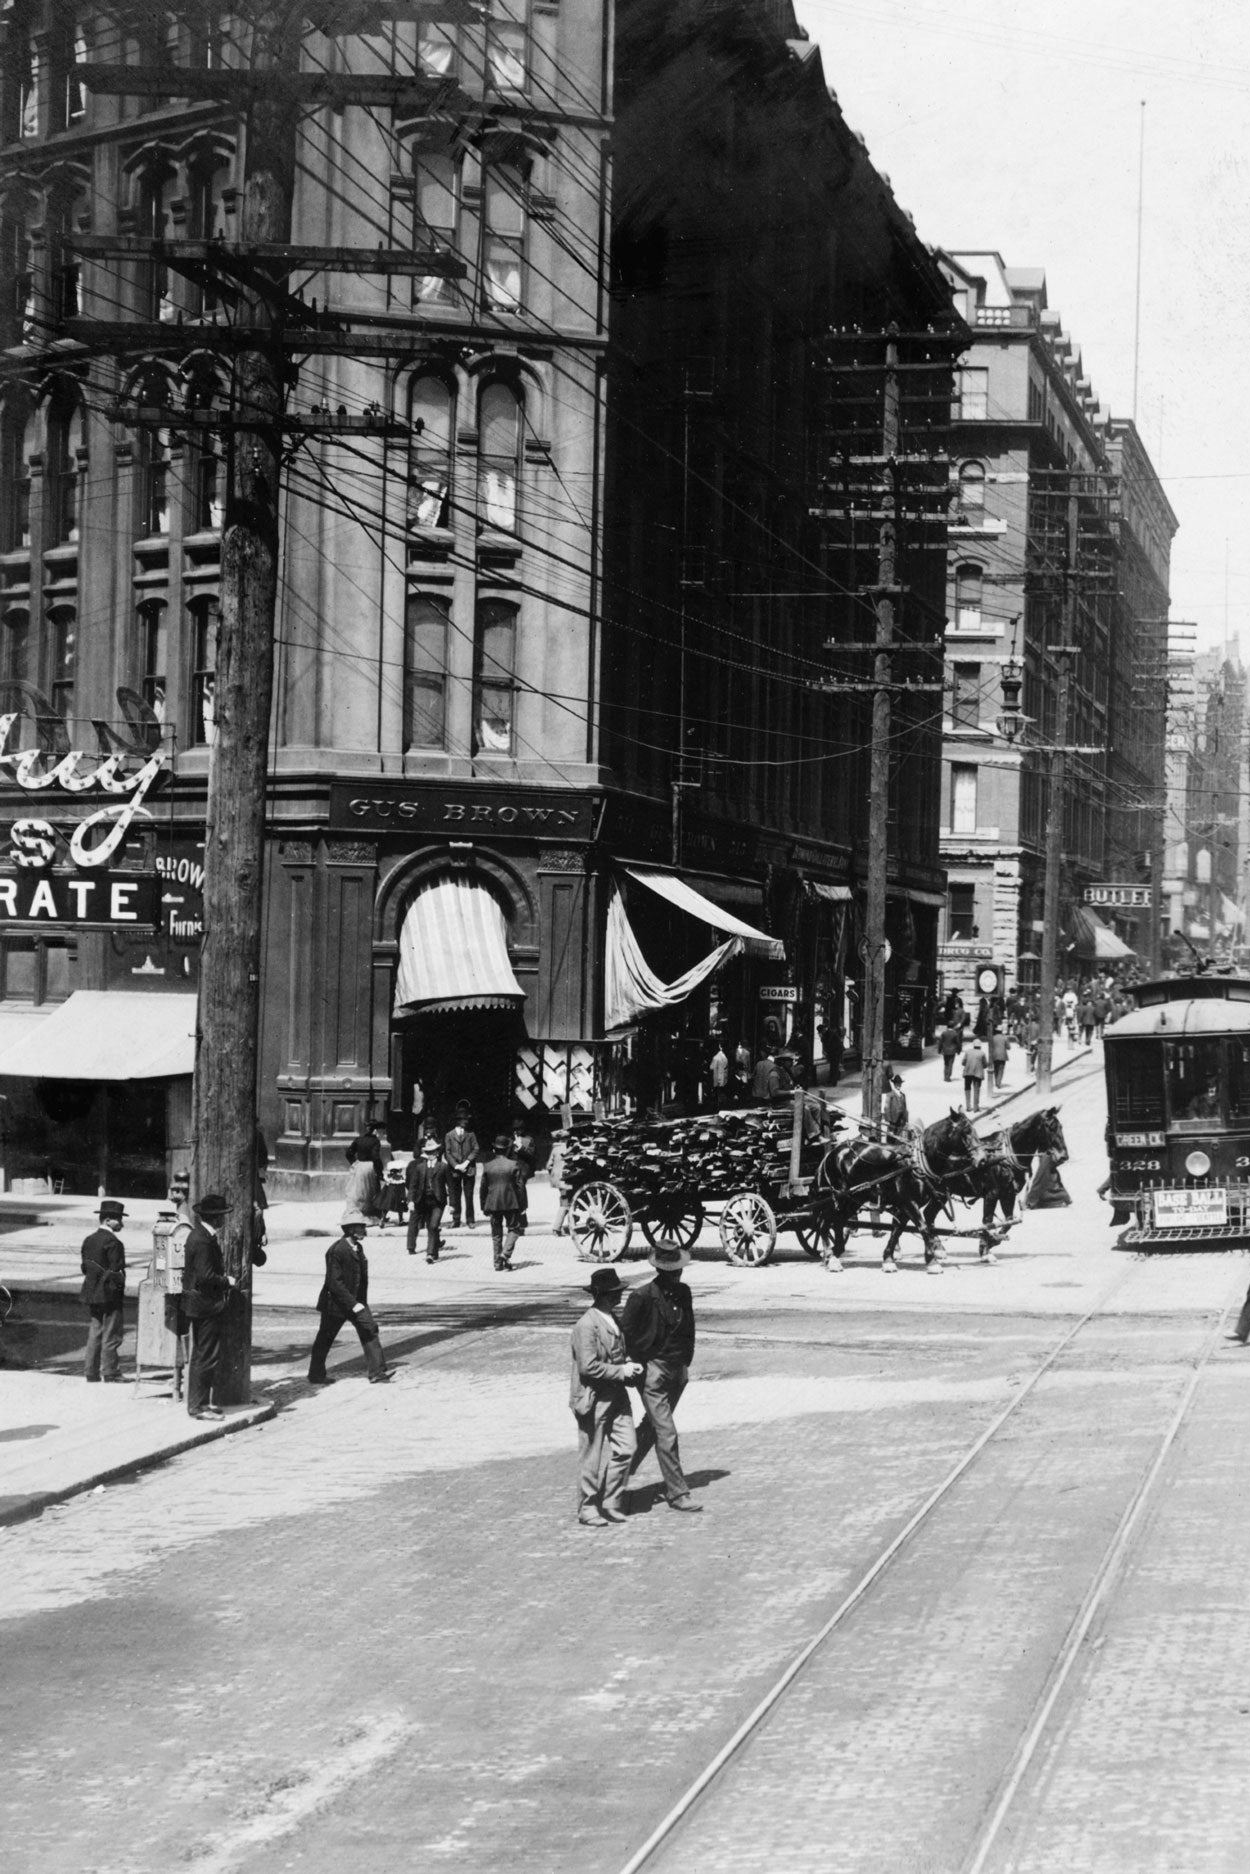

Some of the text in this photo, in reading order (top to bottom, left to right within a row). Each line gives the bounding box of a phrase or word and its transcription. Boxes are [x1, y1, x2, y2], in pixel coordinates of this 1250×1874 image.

[350, 798, 579, 825] GUS BROWN
[155, 856, 206, 894] BROW
[0, 878, 139, 920] RATE
[760, 988, 796, 998] CIGARS
[1119, 1159, 1161, 1171] 328
[1171, 1204, 1210, 1214] TO-DAY
